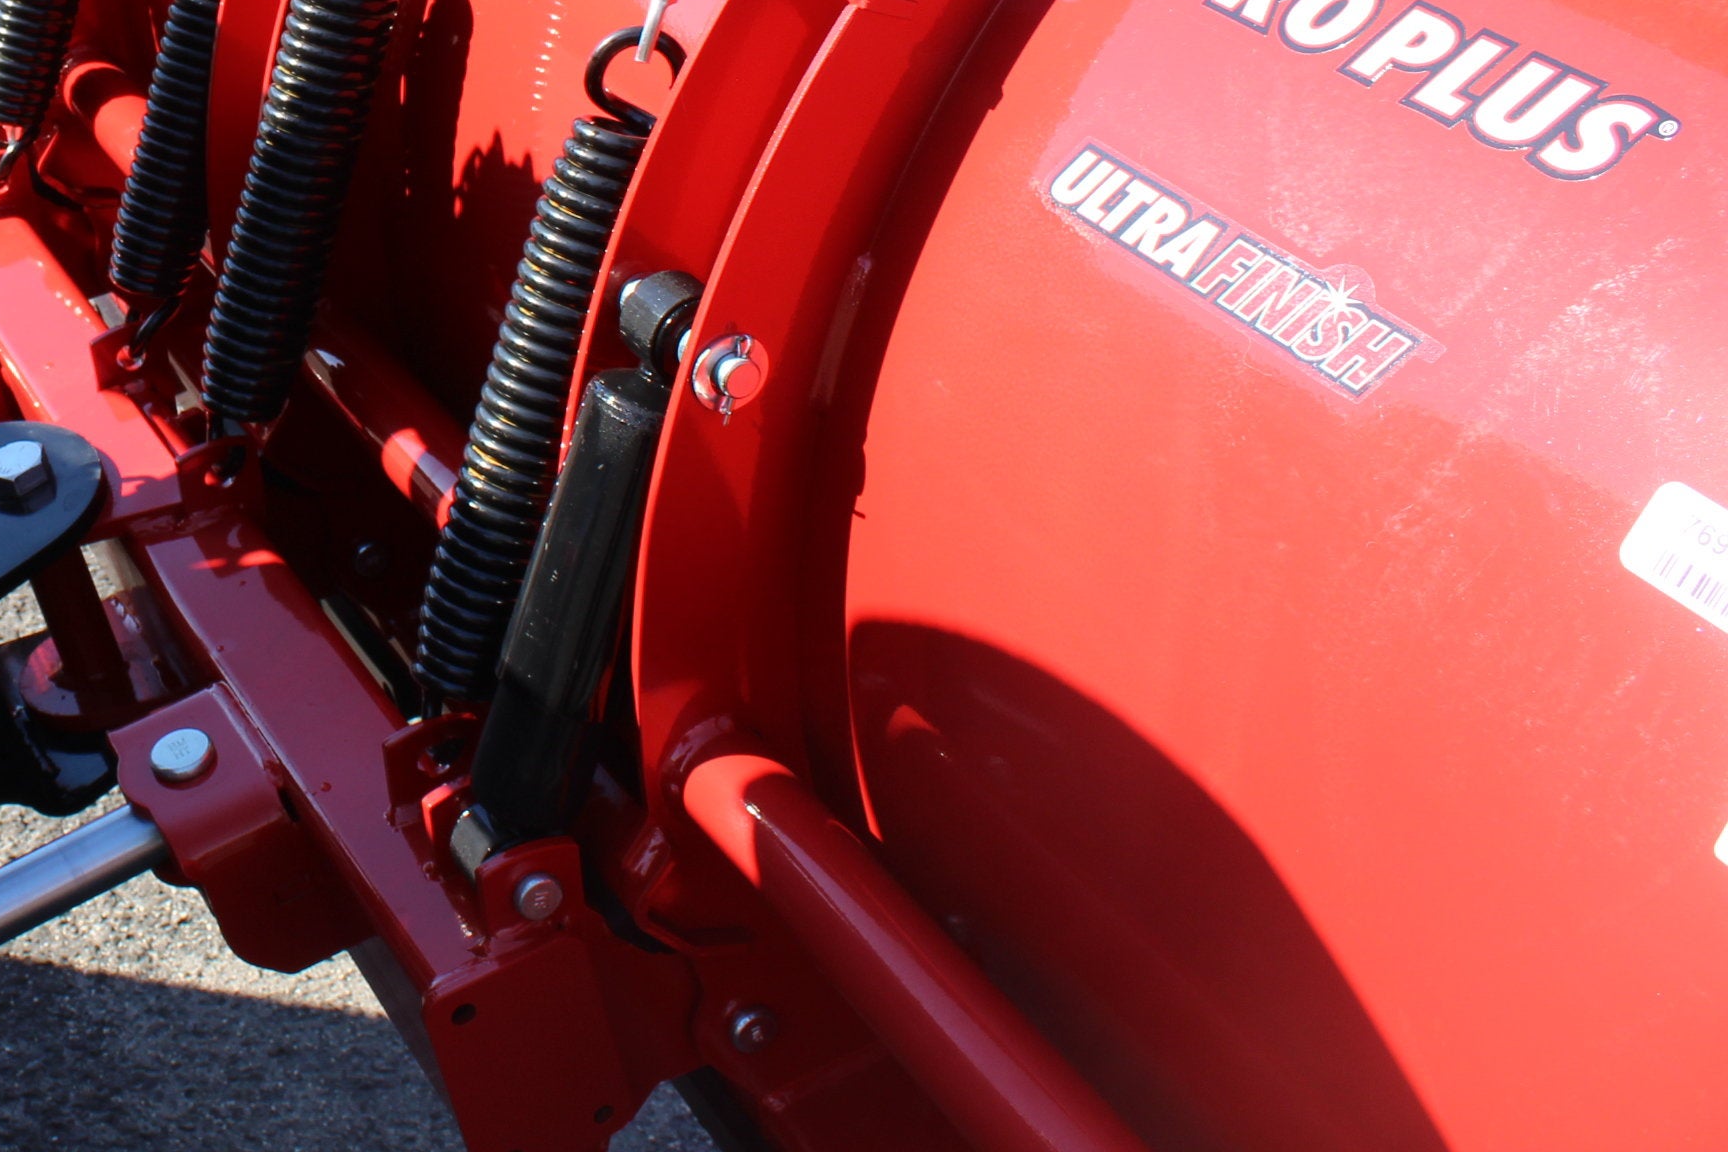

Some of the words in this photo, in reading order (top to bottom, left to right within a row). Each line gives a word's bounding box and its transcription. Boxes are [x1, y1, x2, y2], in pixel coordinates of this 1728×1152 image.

[1336, 0, 1668, 182] PLUS
[1048, 143, 1228, 282] ULTRA
[1196, 234, 1422, 396] FINISH
